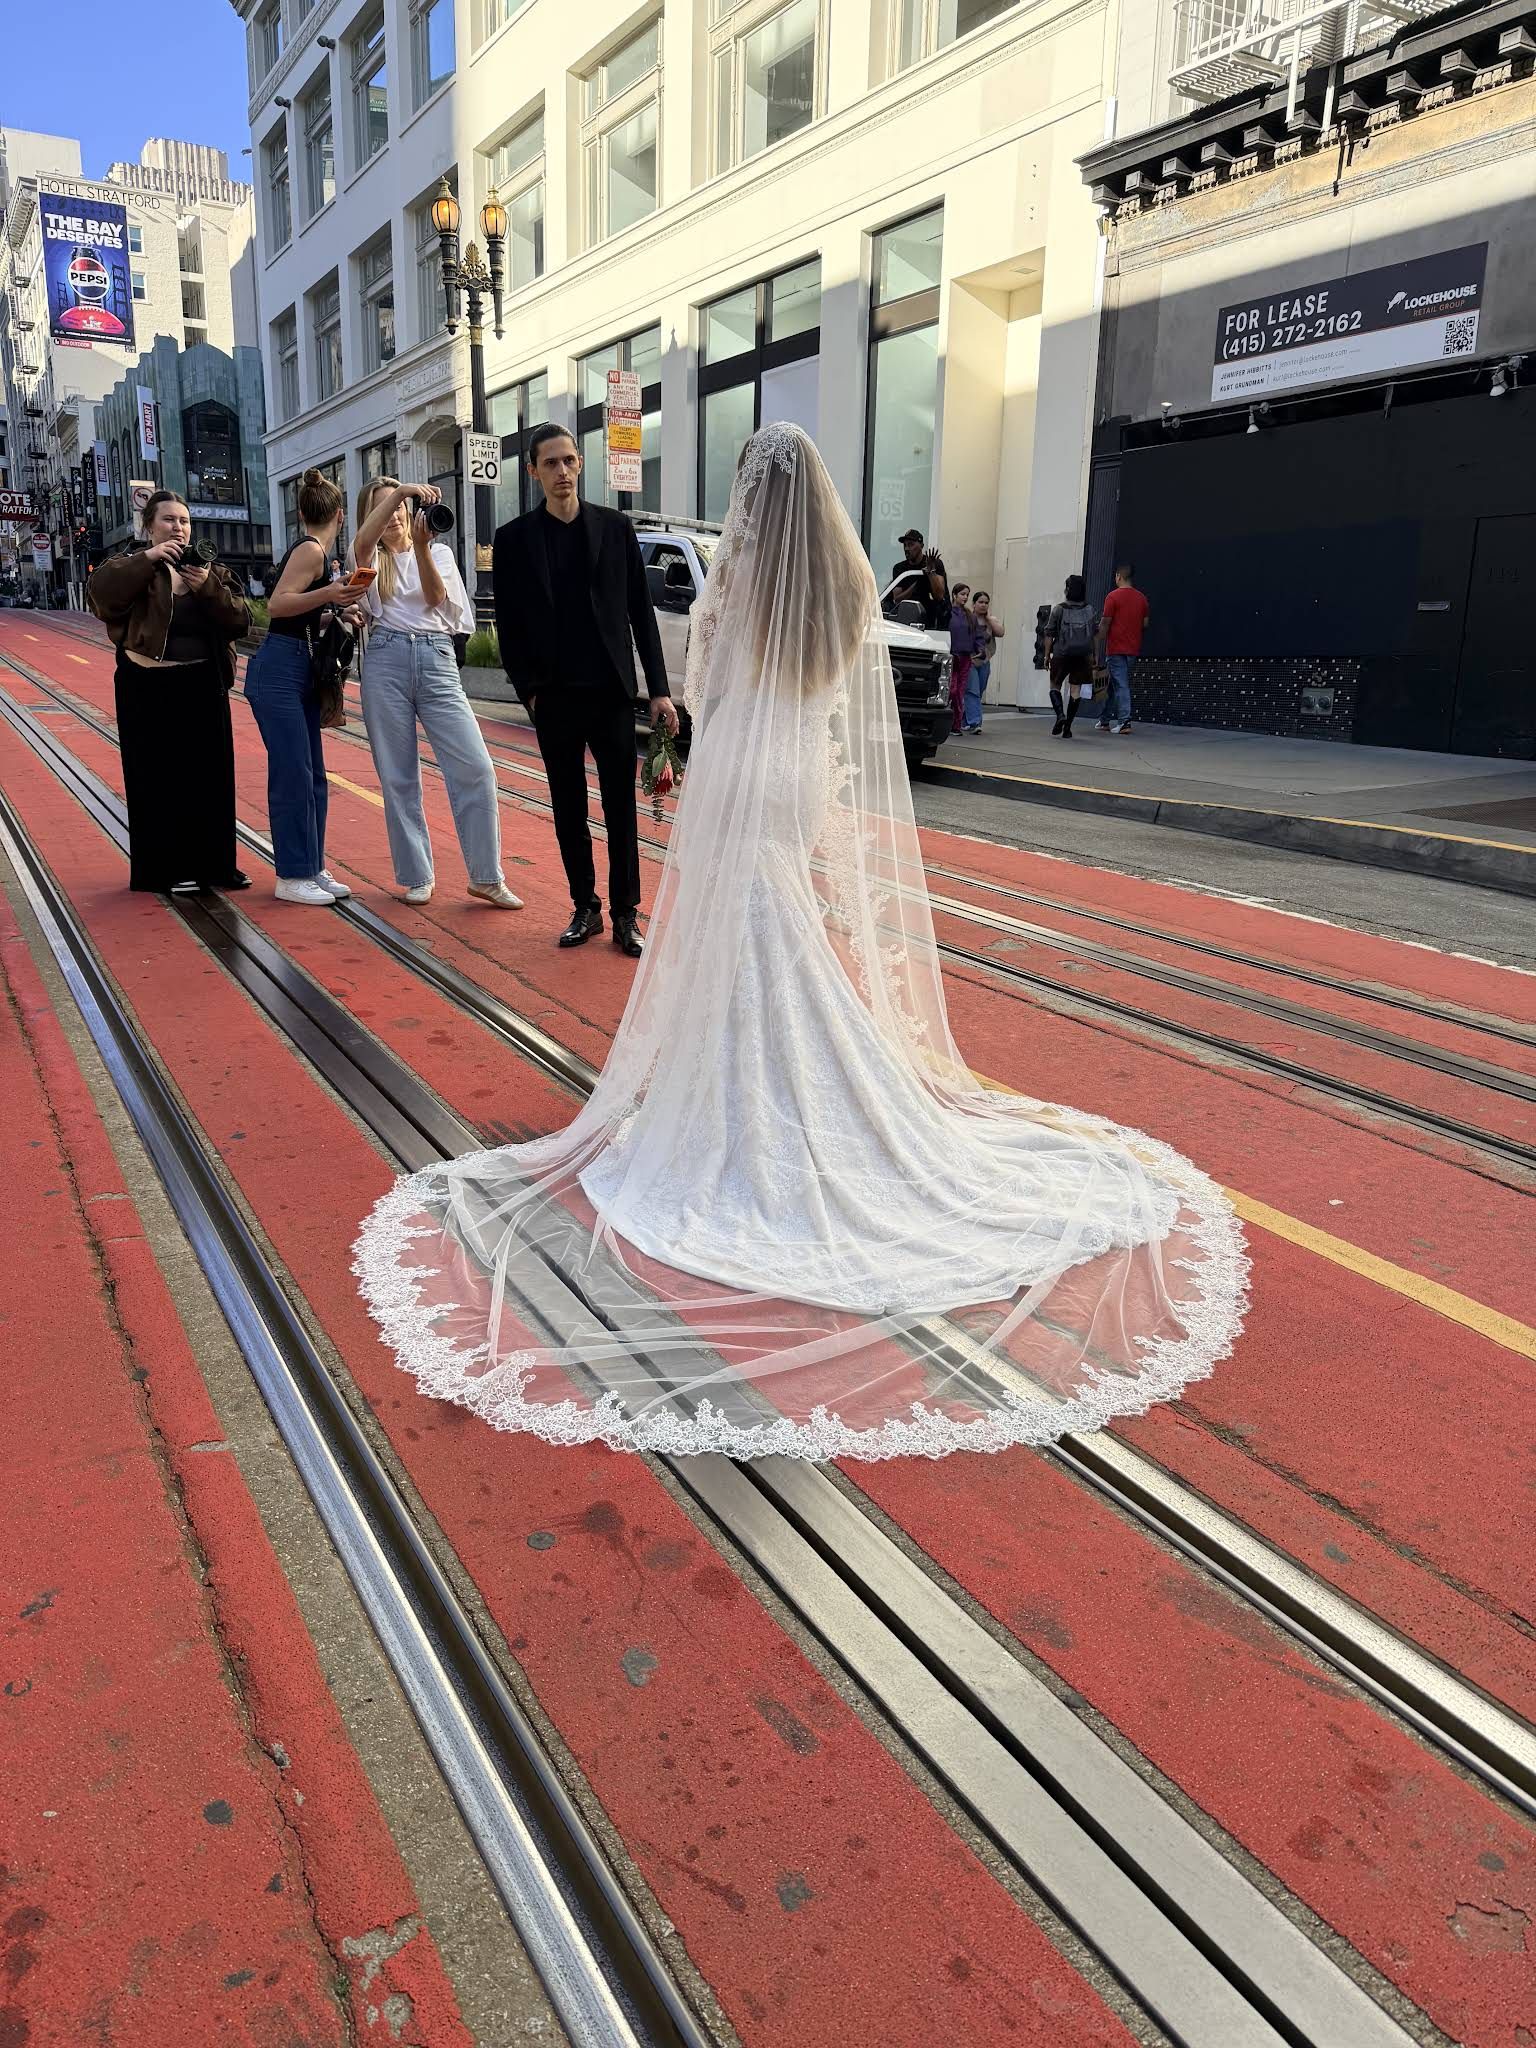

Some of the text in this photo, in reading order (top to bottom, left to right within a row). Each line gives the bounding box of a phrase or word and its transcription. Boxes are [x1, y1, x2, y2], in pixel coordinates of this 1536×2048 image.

[41, 179, 160, 210] HOTEL STRATFORD
[45, 212, 123, 238] THE BAY
[46, 227, 123, 249] DESERVES
[70, 272, 107, 285] PEPSI
[1404, 284, 1478, 310] LOCKEHOUSE
[1225, 291, 1329, 335] FOR LEASE
[1413, 300, 1465, 317] RETAIL GROUP
[1222, 310, 1363, 359] (415) 272-2162
[610, 372, 619, 382] NO
[609, 416, 619, 425] NO
[611, 410, 639, 418] TOW-AWAY
[143, 404, 154, 444] POP MART
[469, 438, 498, 449] SPEED
[472, 449, 495, 459] LIMIT
[610, 454, 640, 466] NO PARKING
[471, 460, 498, 480] 20
[0, 493, 31, 506] OTE
[87, 482, 95, 504] SHOP
[189, 506, 246, 519] POP MART
